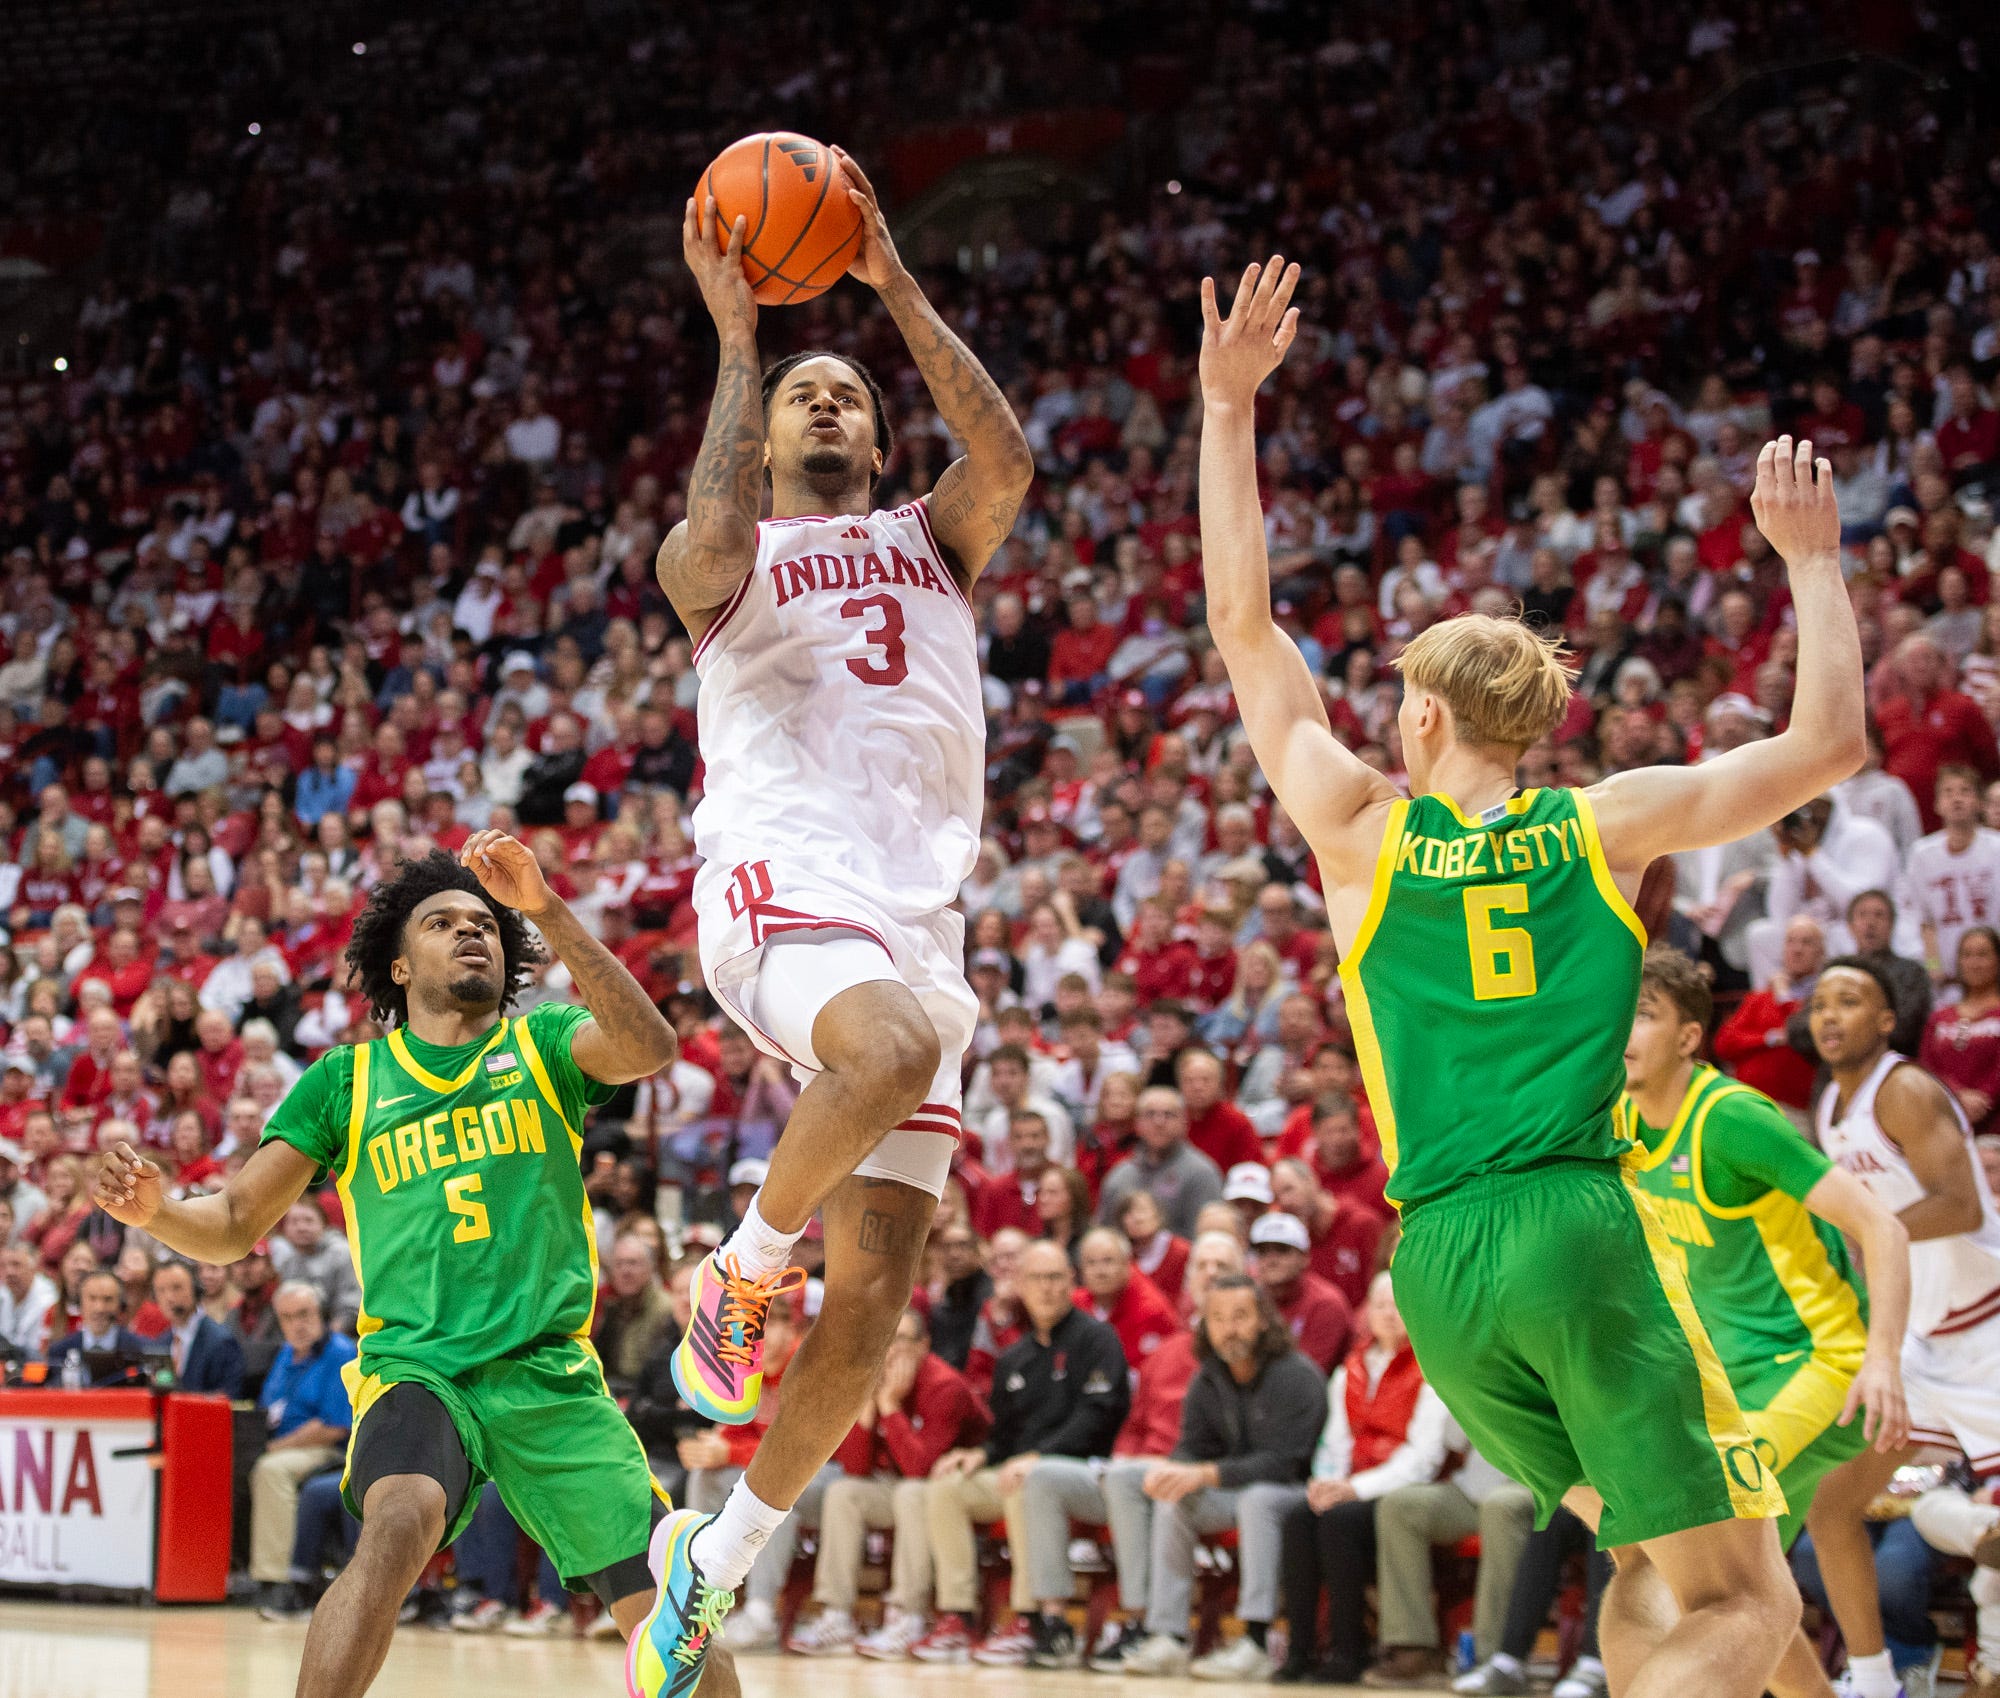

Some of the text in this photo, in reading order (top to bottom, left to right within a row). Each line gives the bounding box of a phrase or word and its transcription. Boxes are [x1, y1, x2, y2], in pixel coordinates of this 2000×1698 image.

[770, 546, 949, 608] INDIANA
[840, 593, 909, 687] 3
[1396, 818, 1586, 879] KOBZYSTYI
[1463, 884, 1538, 1001] 6
[368, 1099, 547, 1195] OREGON
[443, 1173, 491, 1244] 5
[0, 1430, 103, 1517] NA
